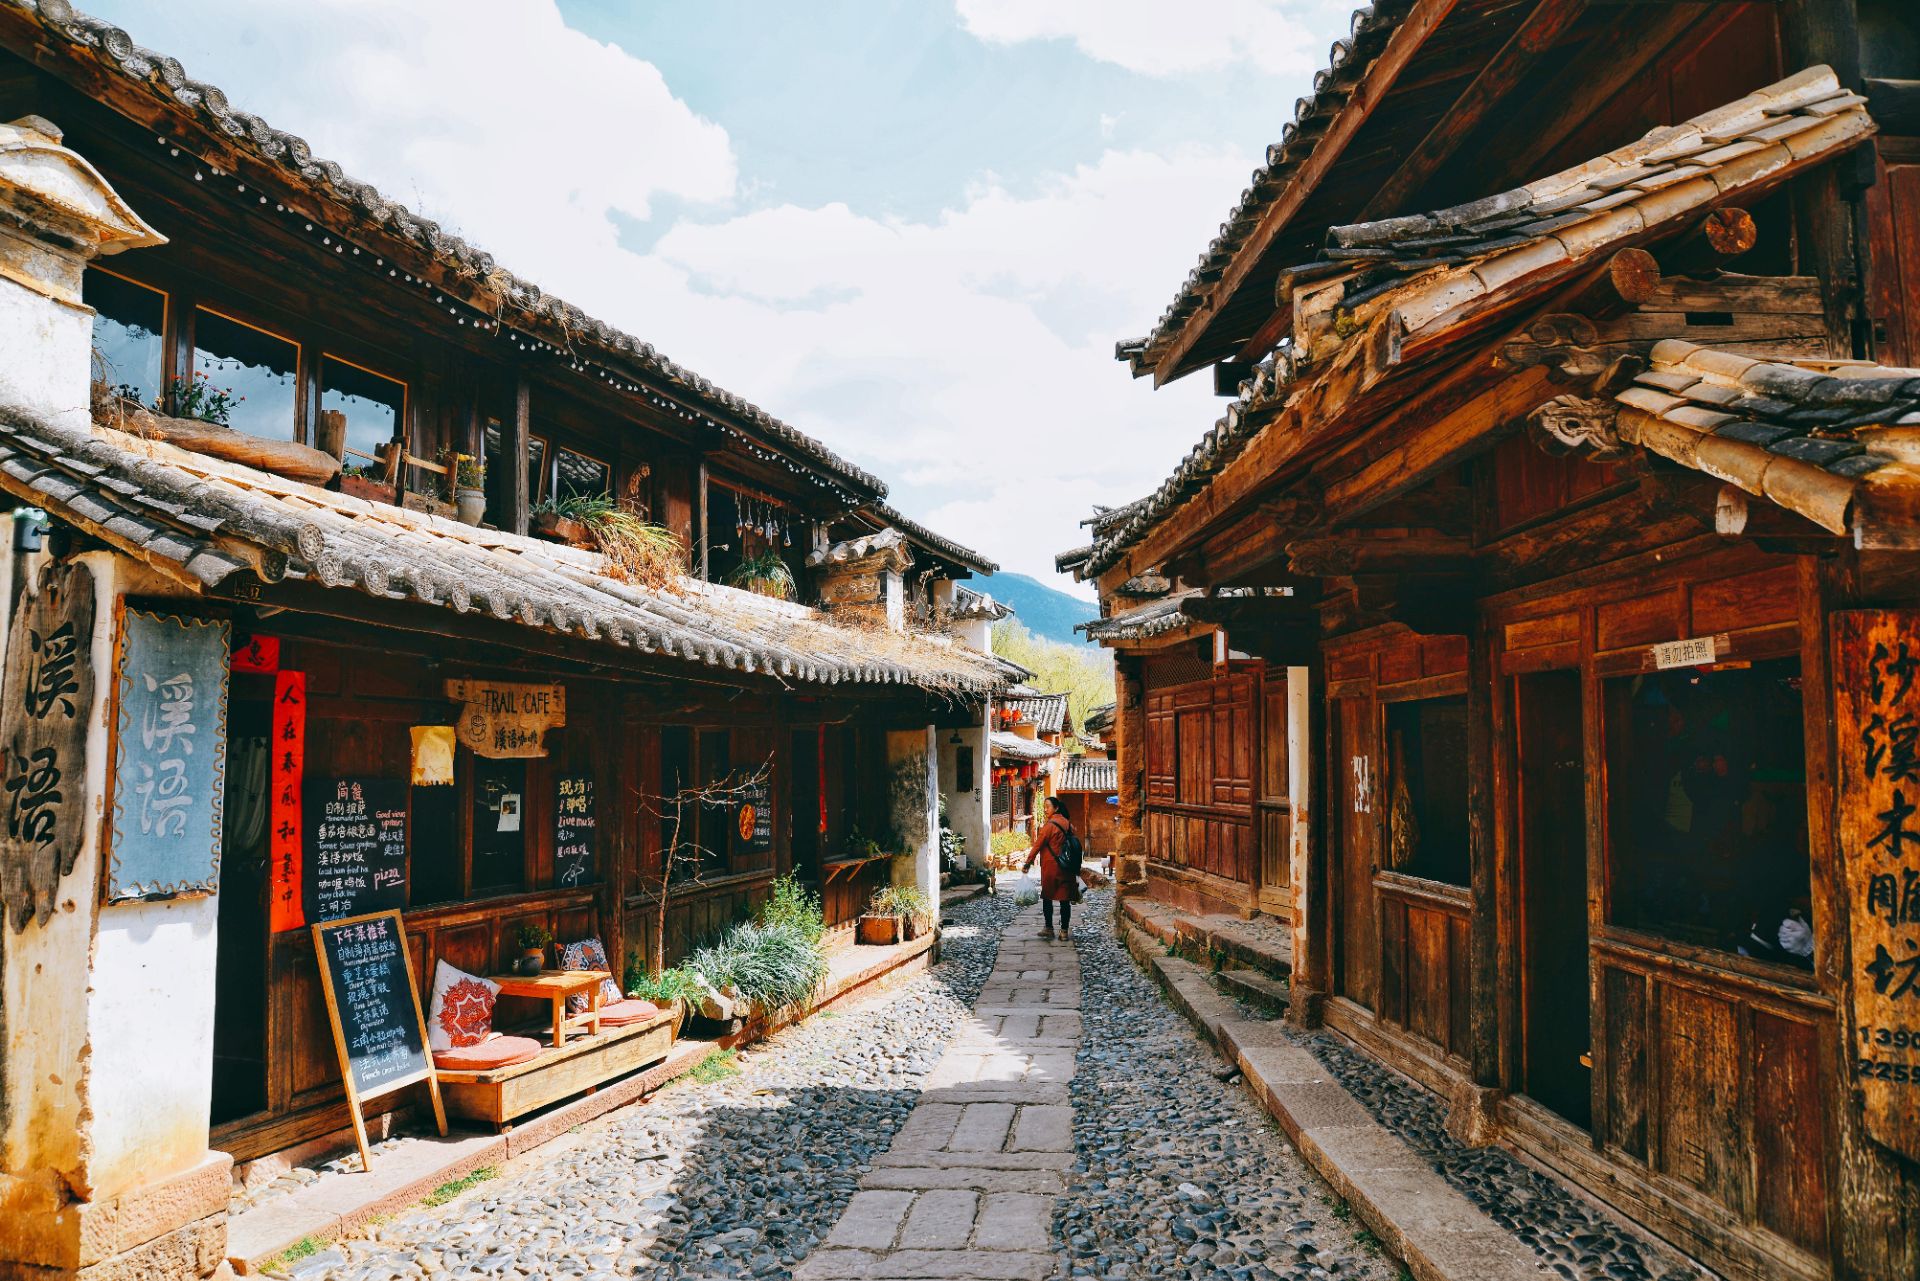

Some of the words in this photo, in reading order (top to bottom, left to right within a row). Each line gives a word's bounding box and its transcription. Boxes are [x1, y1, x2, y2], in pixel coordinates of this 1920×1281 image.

[1661, 640, 1708, 664] 请勿拍照
[482, 690, 518, 713] TRAIL
[524, 692, 550, 714] CAFE
[5, 622, 79, 850] 溪语
[136, 672, 196, 840] 溪语
[373, 867, 401, 891] pizza
[318, 899, 352, 913] 三明治
[333, 920, 388, 946] 下午茶推荐
